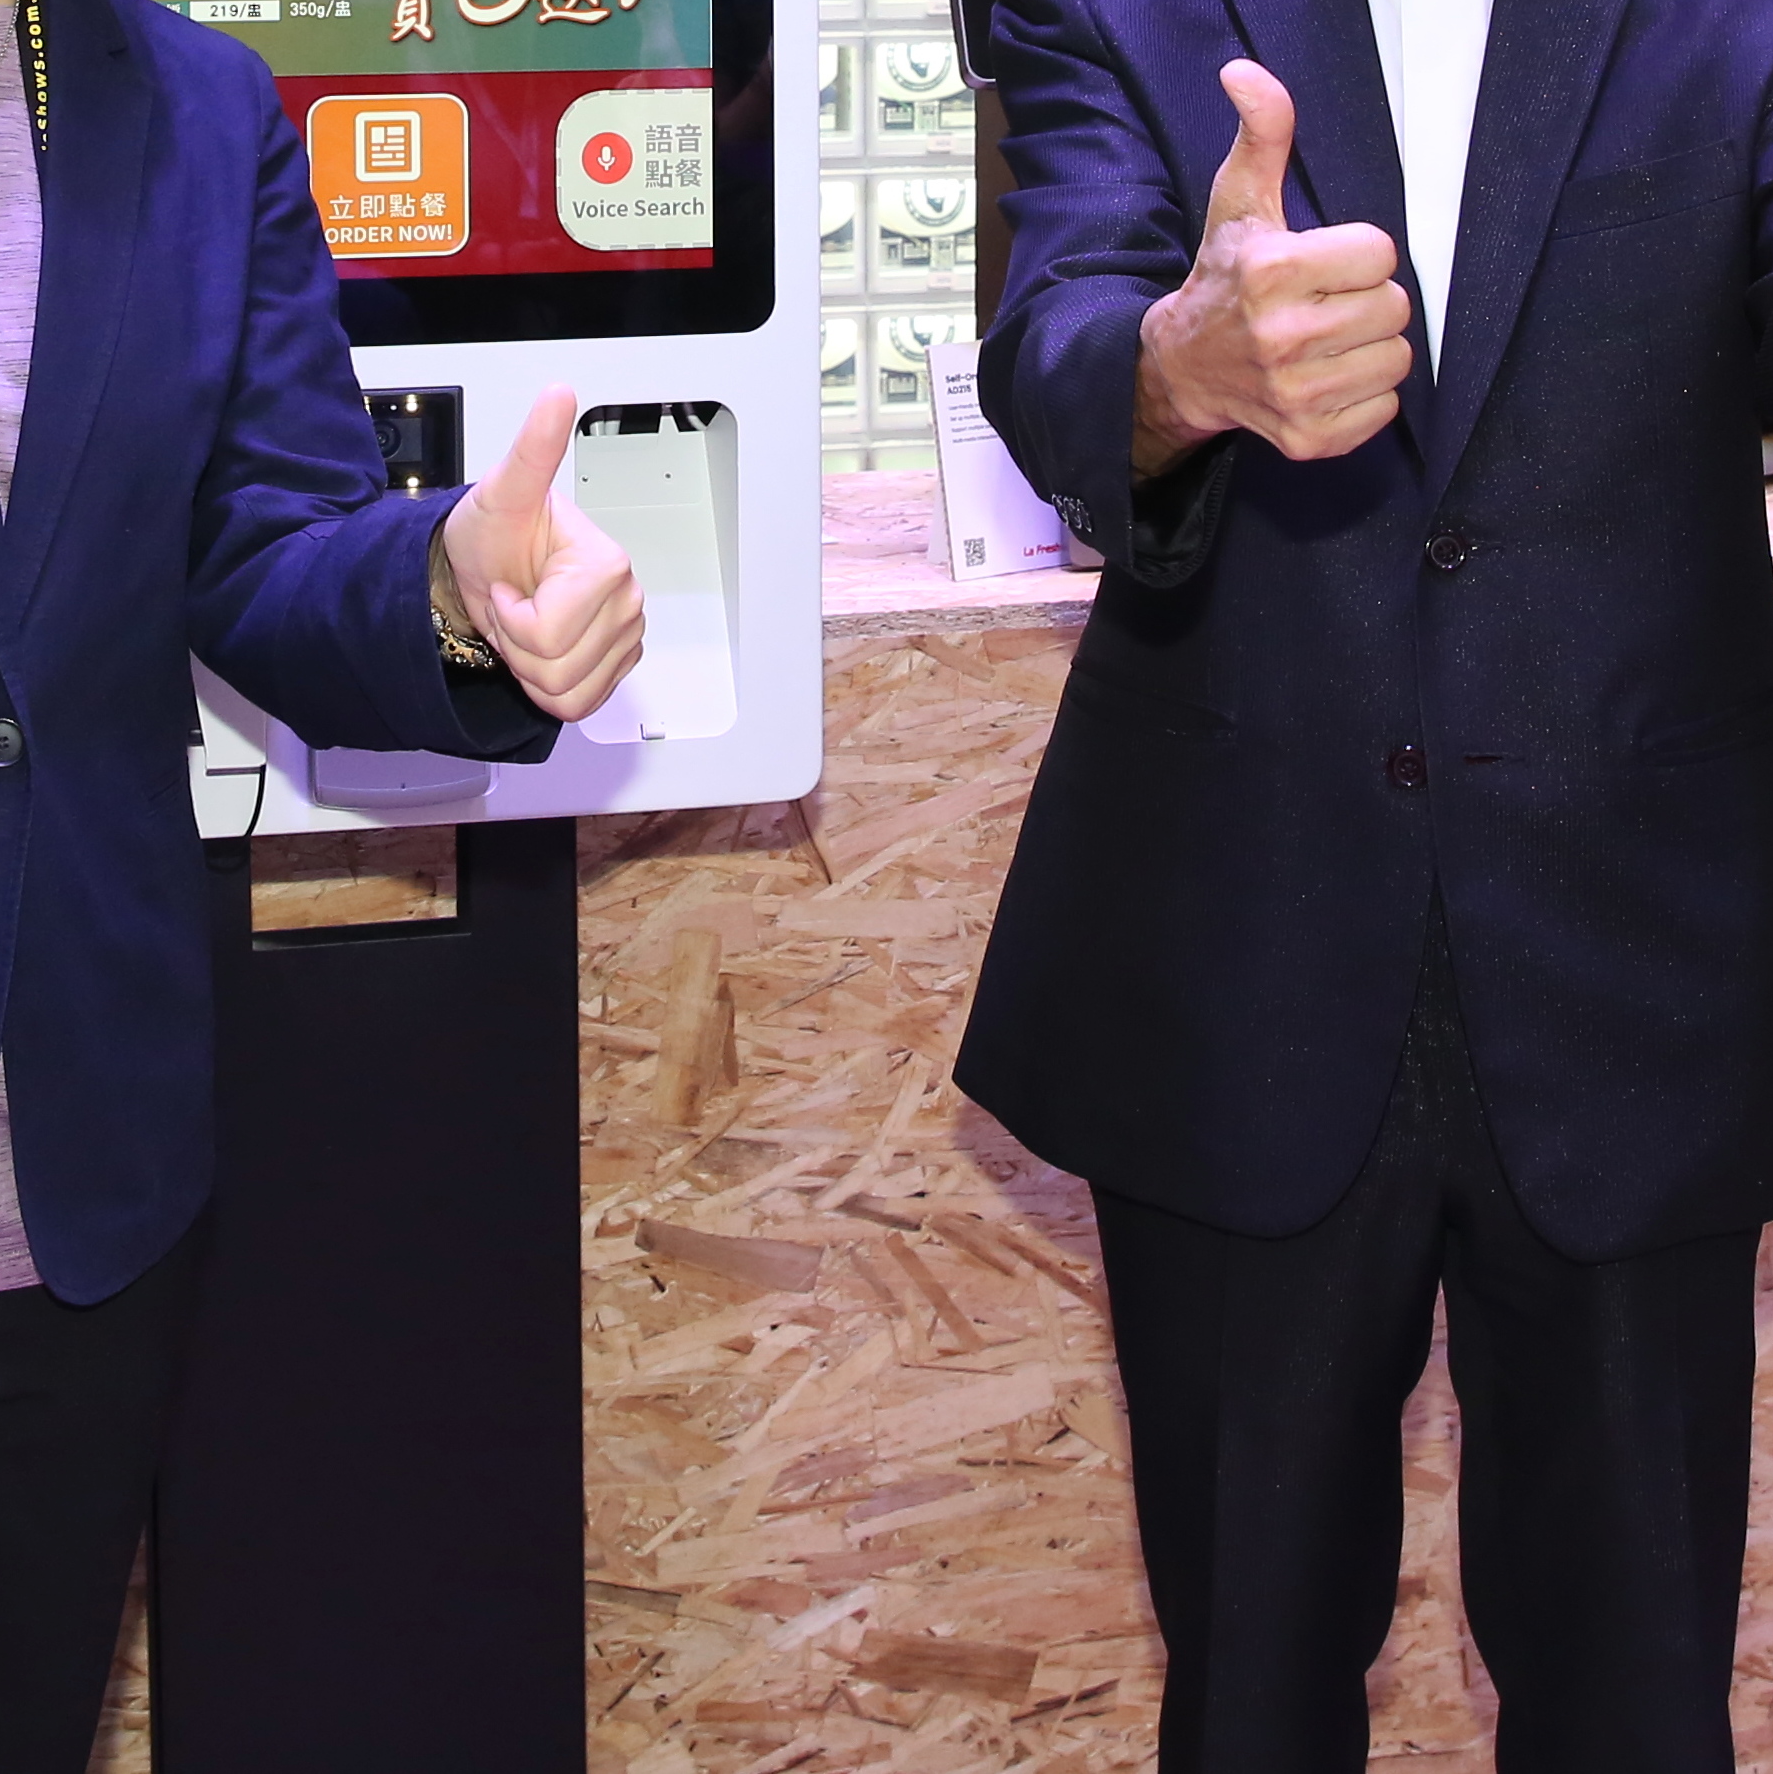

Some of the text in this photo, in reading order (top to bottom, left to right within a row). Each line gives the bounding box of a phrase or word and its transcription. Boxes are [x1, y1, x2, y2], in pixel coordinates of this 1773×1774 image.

[210, 4, 261, 17] 219/盅
[644, 124, 702, 155] 語音
[644, 158, 703, 190] 點餐
[328, 193, 448, 220] 立即點餐
[571, 196, 706, 221] Voice Search
[325, 223, 454, 245] ORDER NOW!
